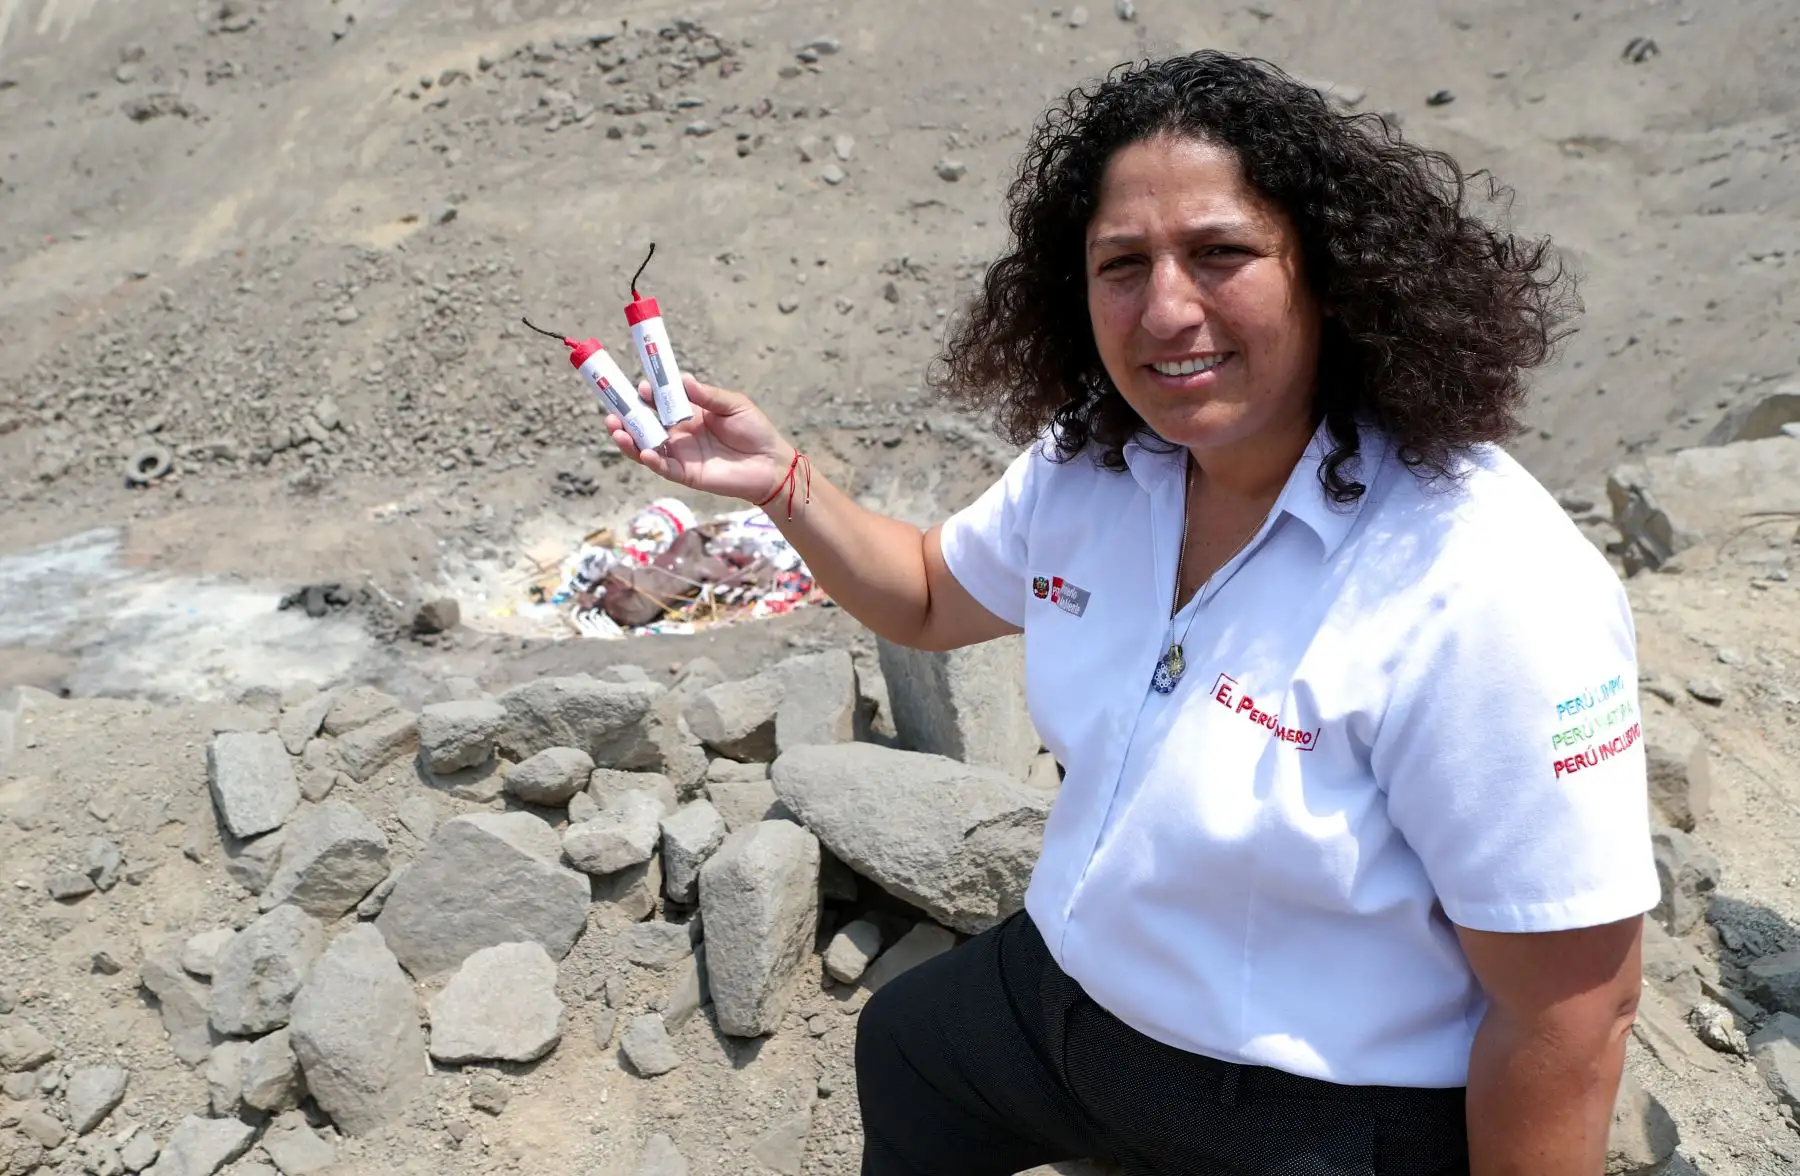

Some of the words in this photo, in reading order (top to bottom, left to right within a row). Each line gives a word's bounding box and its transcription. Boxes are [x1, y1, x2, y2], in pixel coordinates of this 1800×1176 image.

[1216, 684, 1233, 709] EL
[1236, 695, 1279, 730] PERÚ
[1556, 687, 1595, 720] PERÚ
[1552, 716, 1595, 750] PERÚ
[1553, 744, 1598, 779] PERÚ
